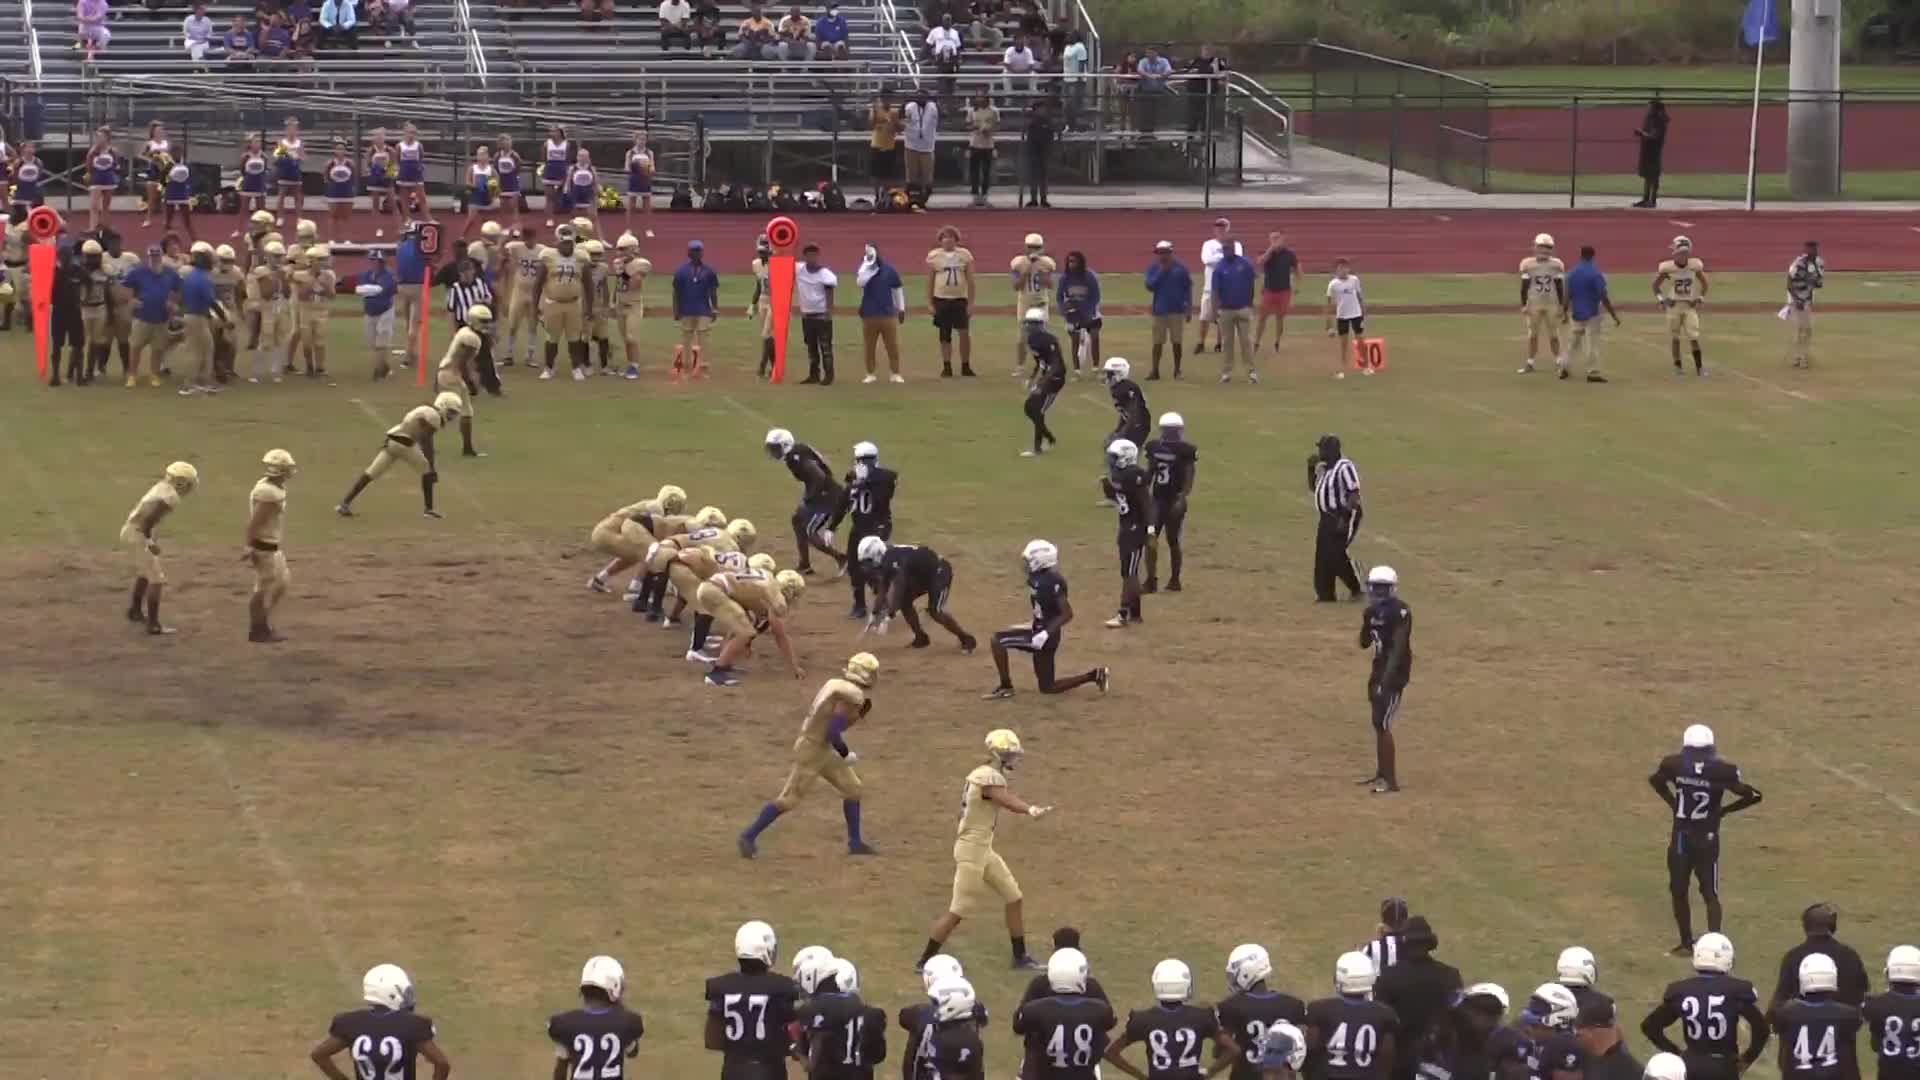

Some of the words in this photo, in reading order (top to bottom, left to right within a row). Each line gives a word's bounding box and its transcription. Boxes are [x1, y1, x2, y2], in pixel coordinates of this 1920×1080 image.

[421, 226, 438, 253] 3
[943, 267, 959, 288] 71
[1535, 275, 1553, 293] 53
[1674, 279, 1693, 295] 22
[1675, 788, 1710, 819] 12
[724, 993, 769, 1041] 57
[1681, 994, 1727, 1041] 35
[1883, 1015, 1920, 1059] 83
[351, 1034, 404, 1080] 62
[573, 1033, 620, 1080] 22
[1046, 1023, 1093, 1068] 48
[1149, 1027, 1200, 1070] 82
[1327, 1021, 1377, 1067] 40
[1793, 1024, 1838, 1070] 44
